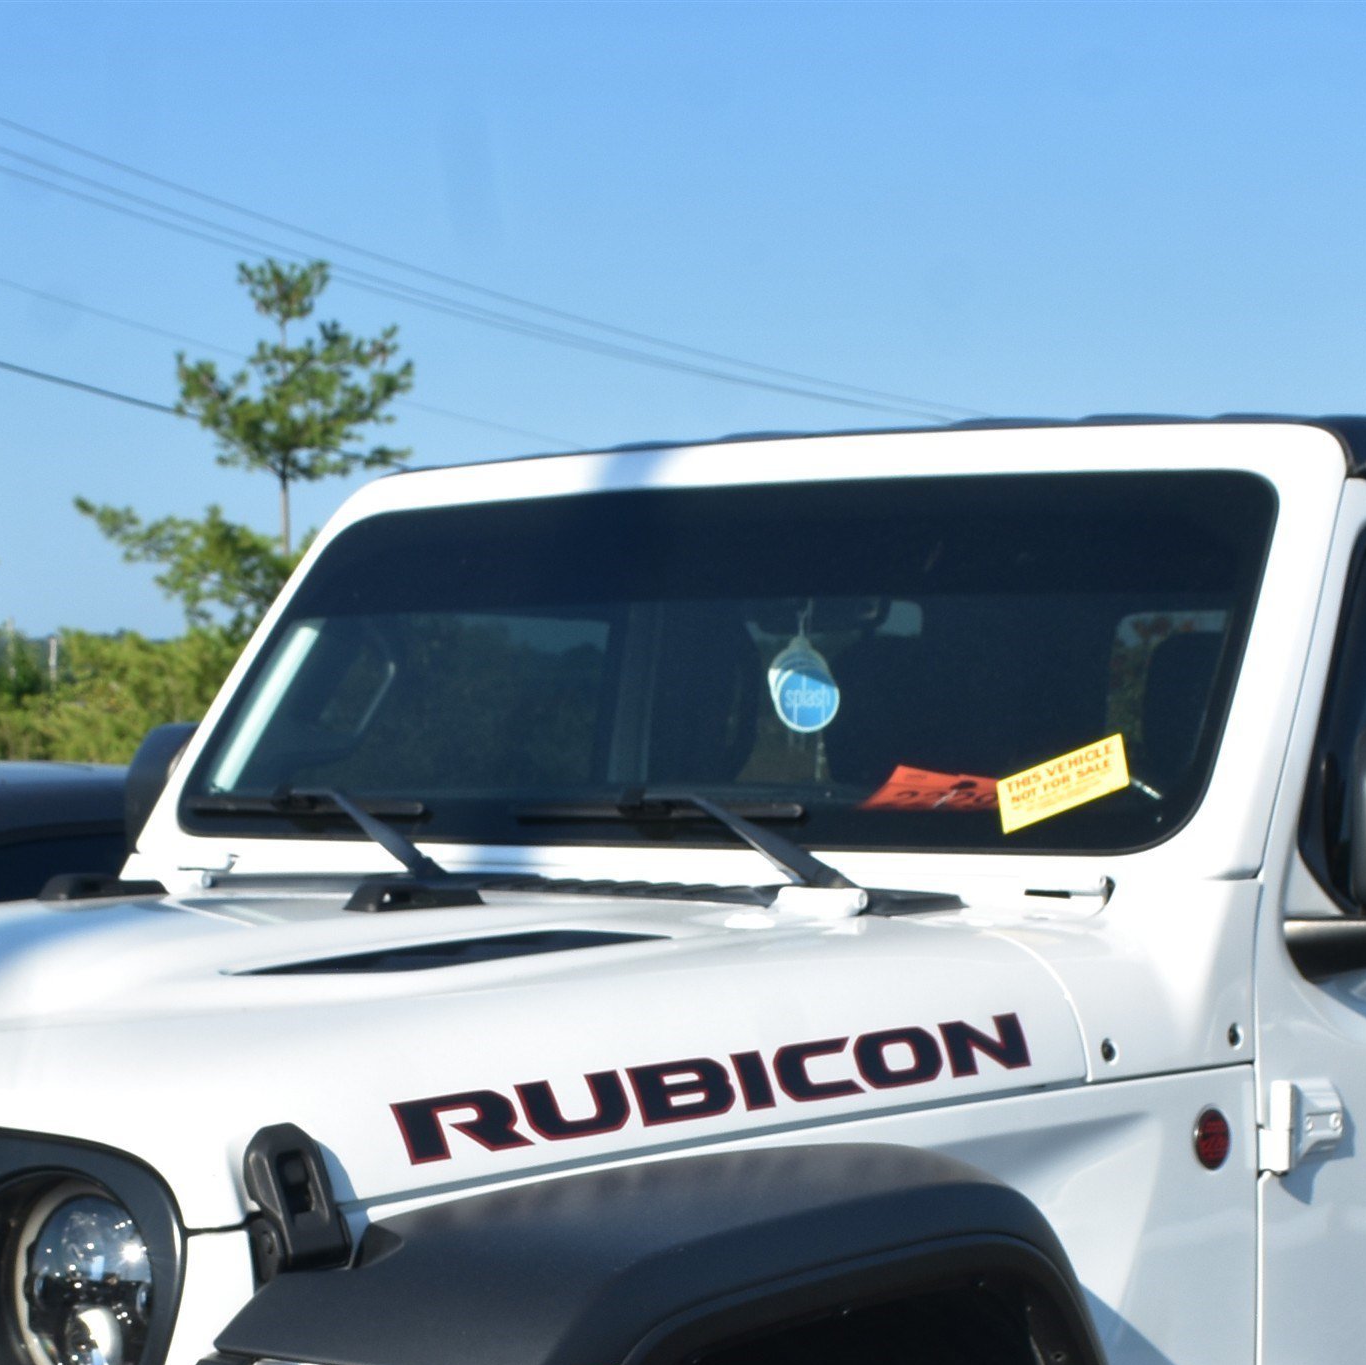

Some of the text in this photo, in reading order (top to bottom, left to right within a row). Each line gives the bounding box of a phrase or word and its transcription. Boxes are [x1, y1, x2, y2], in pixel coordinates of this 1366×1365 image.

[1007, 743, 1112, 793] THIS VEHICLE
[1011, 787, 1036, 803] NOT
[1043, 775, 1071, 791] FOR
[1076, 760, 1110, 778] SALE
[390, 1012, 1032, 1166] RUBICON
